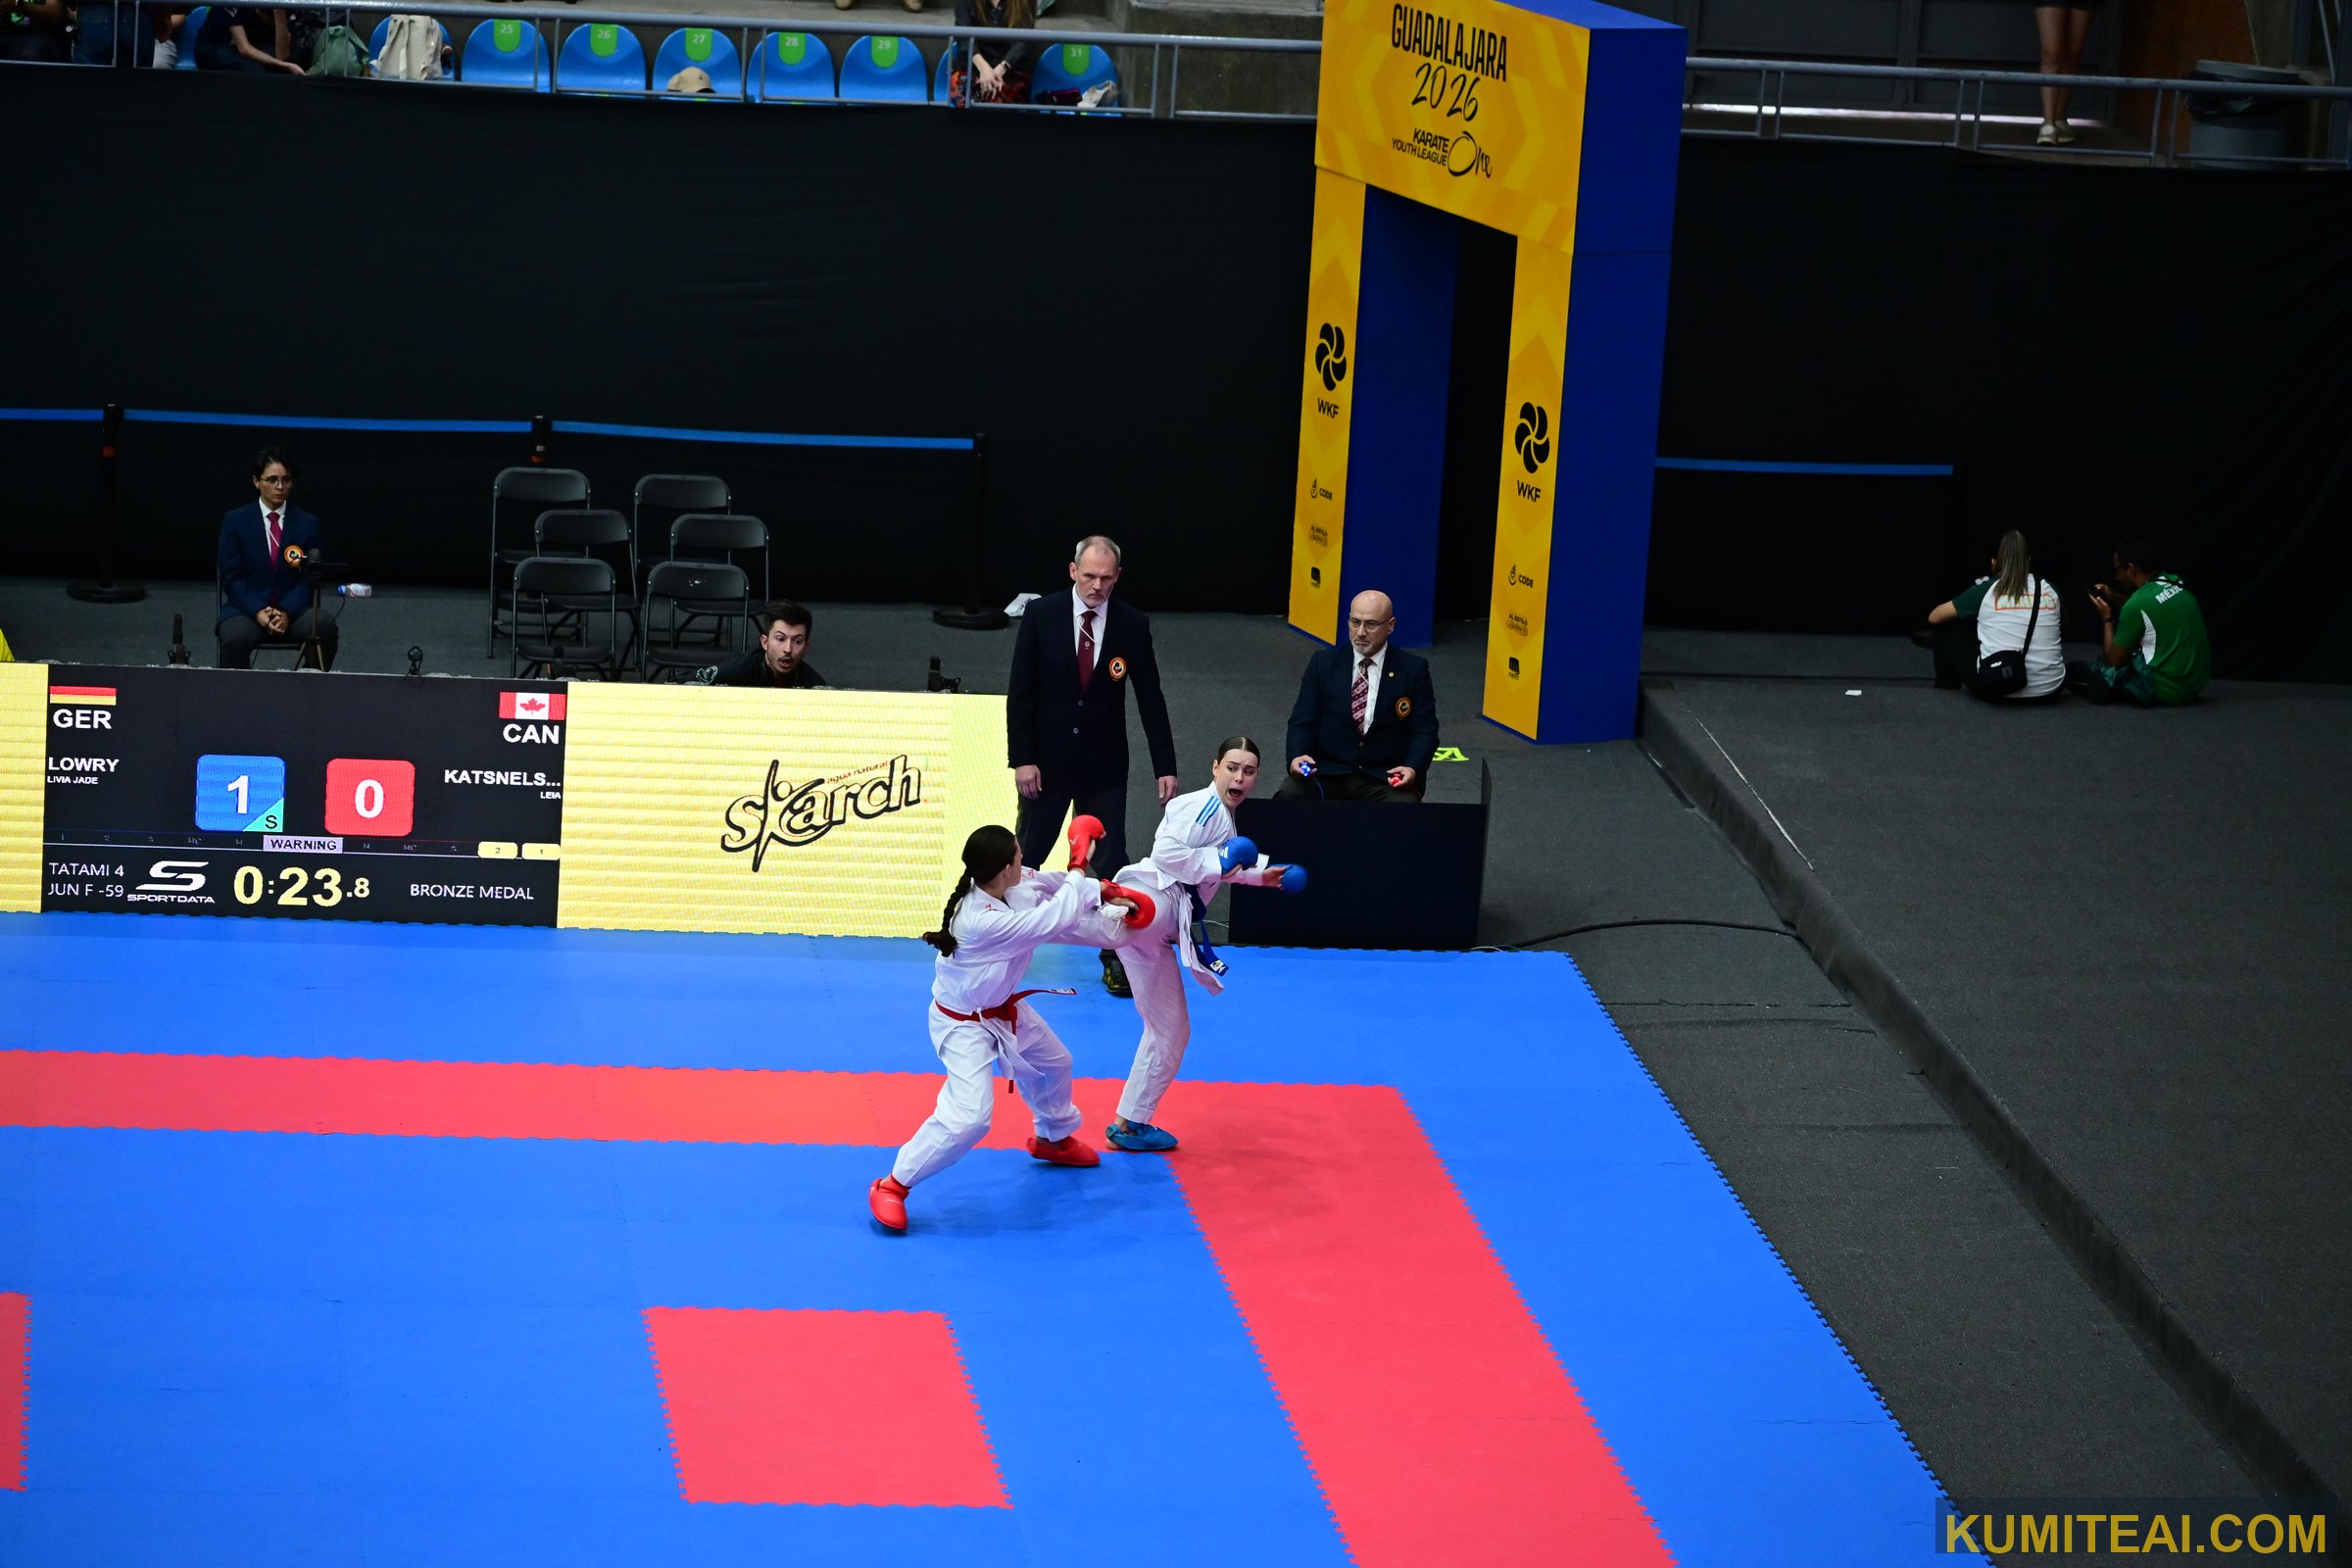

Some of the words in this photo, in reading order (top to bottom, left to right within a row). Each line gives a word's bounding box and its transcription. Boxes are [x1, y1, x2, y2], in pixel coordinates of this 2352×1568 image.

[500, 24, 514, 34] 25
[597, 29, 611, 39] 26
[692, 34, 705, 44] 27
[786, 37, 799, 47] 28
[878, 40, 891, 49] 29
[1392, 3, 1506, 82] GUADALAJARA
[1070, 47, 1083, 58] 31
[1411, 62, 1481, 122] 2026
[1413, 127, 1450, 154] KARATE
[1392, 138, 1417, 157] YOUTH
[1417, 146, 1447, 167] LEAGUE
[1317, 397, 1340, 419] WKF
[1516, 479, 1542, 503] WKF
[1518, 574, 1534, 588] CODE
[53, 709, 112, 729] GER
[503, 723, 560, 745] CAN
[48, 757, 120, 773] LOWRY
[47, 775, 72, 785] LIVIA
[73, 776, 99, 785] JADE
[444, 769, 562, 787] KATSNELS...
[226, 774, 249, 814] 1
[354, 779, 384, 819] 0
[540, 791, 562, 800] LEIA
[265, 814, 278, 829] S
[270, 839, 337, 851] WARNING
[49, 862, 110, 877] TATAMI
[115, 864, 124, 878] 4
[47, 883, 80, 896] JUN
[85, 884, 93, 897] F
[98, 884, 124, 898] -59
[410, 883, 474, 899] BRONZE
[479, 886, 534, 901] MEDAL
[127, 893, 216, 905] SPORTDATA
